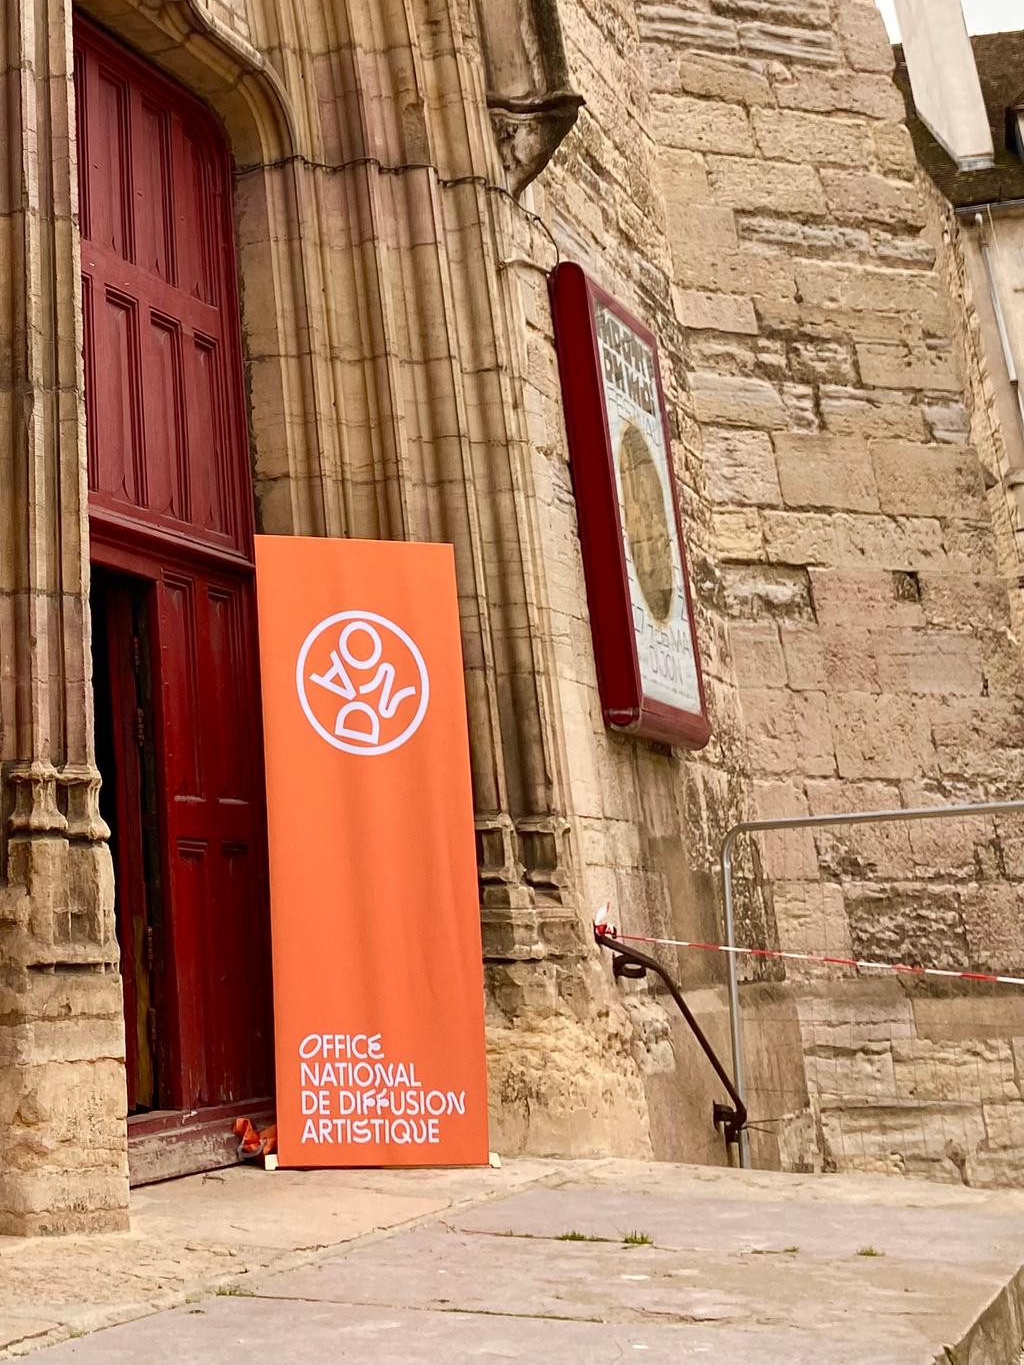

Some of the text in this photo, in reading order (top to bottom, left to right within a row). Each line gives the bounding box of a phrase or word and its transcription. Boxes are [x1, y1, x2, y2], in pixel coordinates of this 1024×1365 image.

[298, 1033, 385, 1060] OFFICE
[300, 1061, 423, 1088] NATIONAL
[301, 1089, 466, 1116] DE DIFFUSION
[301, 1118, 441, 1145] ARTISTIQUE
